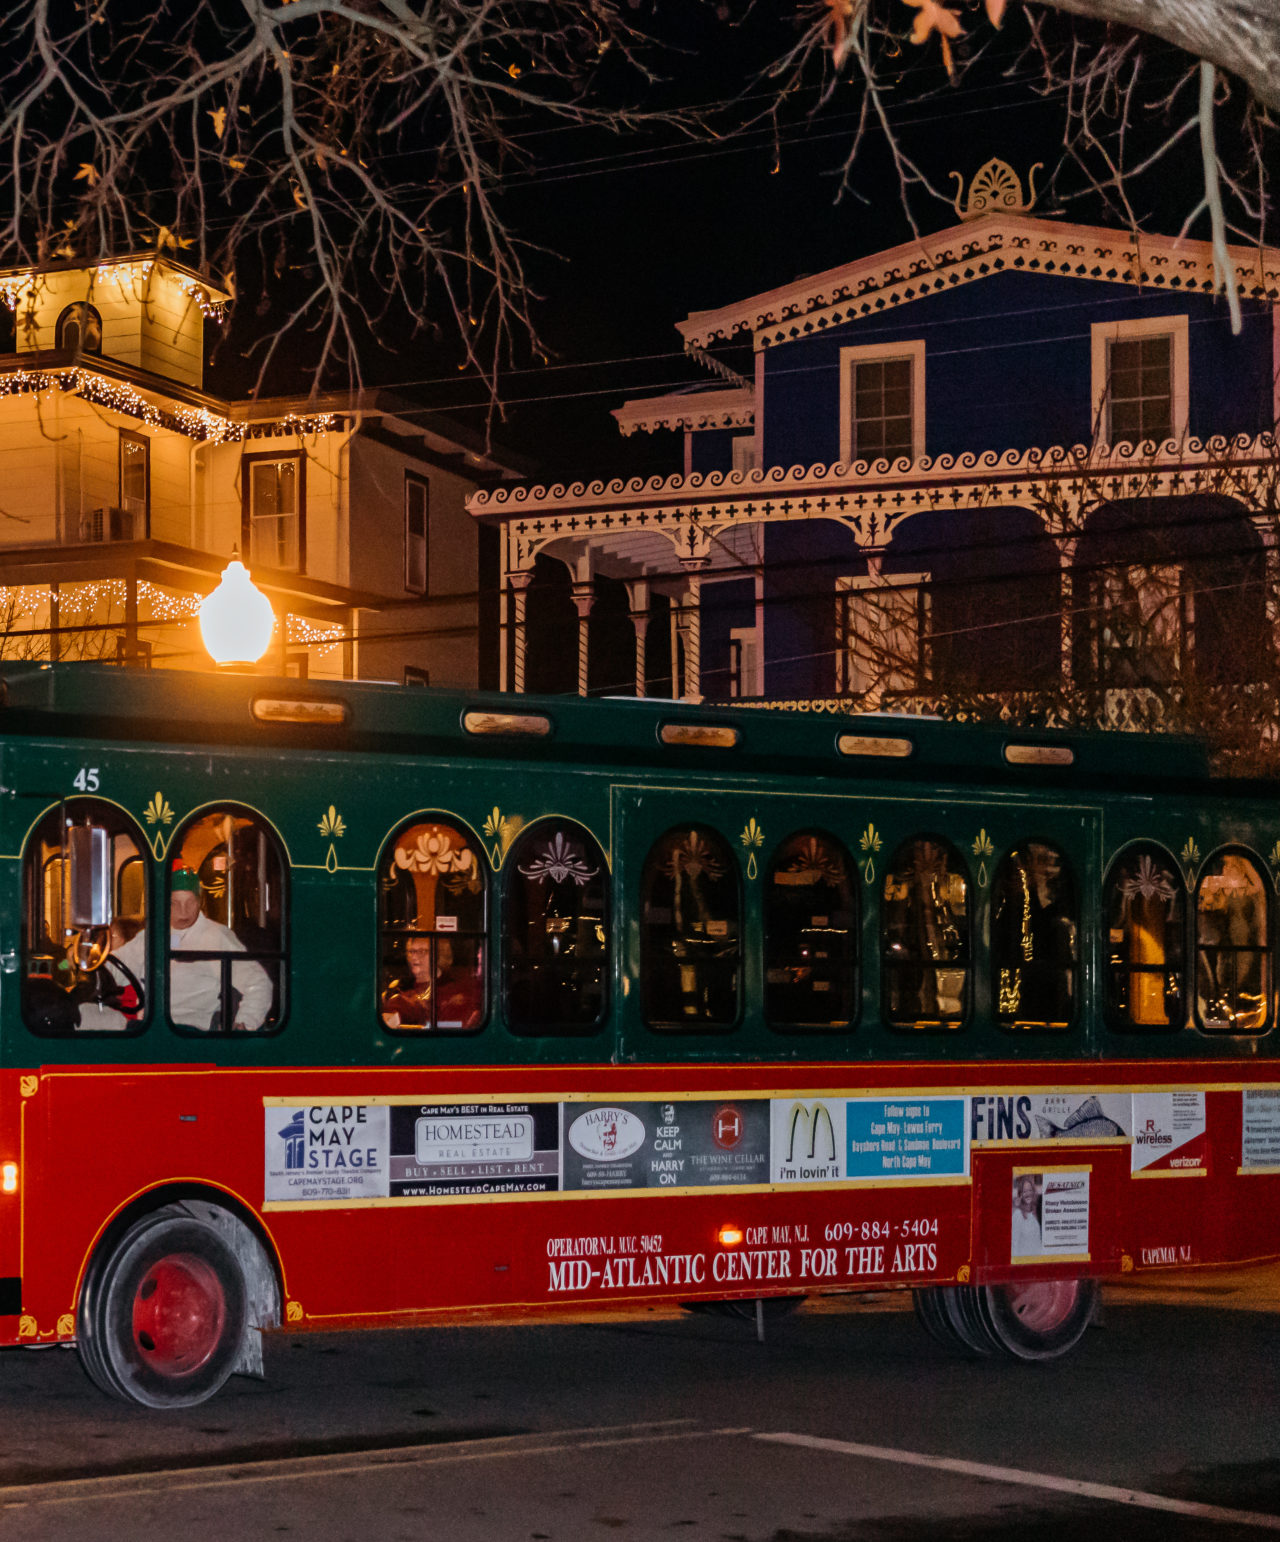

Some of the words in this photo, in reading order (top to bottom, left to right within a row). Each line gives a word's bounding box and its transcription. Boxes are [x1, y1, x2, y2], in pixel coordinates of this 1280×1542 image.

[73, 768, 100, 792] 45
[309, 1106, 367, 1124] CAPE
[461, 1106, 478, 1114] BEST
[884, 1104, 904, 1117] Follow
[906, 1104, 921, 1118] signs
[923, 1104, 929, 1117] to
[584, 1110, 628, 1126] HARRY'S
[425, 1122, 525, 1141] HOMESTEAD
[656, 1126, 679, 1138] KEEP
[718, 1118, 738, 1138] H
[871, 1122, 885, 1136] Cape
[925, 1121, 942, 1135] Ferry
[1146, 1120, 1155, 1132] R
[309, 1127, 355, 1146] MAY
[1136, 1134, 1172, 1144] wireless
[654, 1139, 682, 1151] CALM
[852, 1140, 879, 1154] Bayshore
[880, 1140, 895, 1152] Road
[932, 1138, 960, 1150] Boulevard
[308, 1148, 377, 1168] STAGE
[438, 1149, 465, 1158] REAL
[472, 1147, 511, 1157] ESTATE
[690, 1156, 708, 1165] THE
[709, 1155, 732, 1164] WINE
[734, 1154, 765, 1163] CELLAR
[651, 1160, 685, 1172] HARRY
[882, 1156, 900, 1168] North
[902, 1155, 917, 1169] Cape
[918, 1155, 931, 1168] May
[1170, 1156, 1201, 1168] verizon
[406, 1168, 429, 1177] BUY
[440, 1166, 466, 1176] SELL
[478, 1165, 503, 1174] LIST
[514, 1163, 544, 1173] RENT
[780, 1168, 796, 1179] i'm
[800, 1166, 830, 1179] lovin'
[832, 1166, 839, 1178] it
[288, 1176, 364, 1186] CAPEMAYSTAGE.ORG
[659, 1174, 676, 1184] ON
[746, 1227, 768, 1245] CAPE
[772, 1226, 792, 1244] MAY,
[794, 1225, 810, 1243] N.J.
[547, 1237, 598, 1257] OPERATOR
[599, 1236, 616, 1255] N.J.
[548, 1254, 706, 1291] MID-ATLANTIC
[712, 1250, 791, 1282] CENTER
[799, 1248, 838, 1277] FOR
[845, 1246, 884, 1275] THE
[890, 1243, 937, 1273] ARTS
